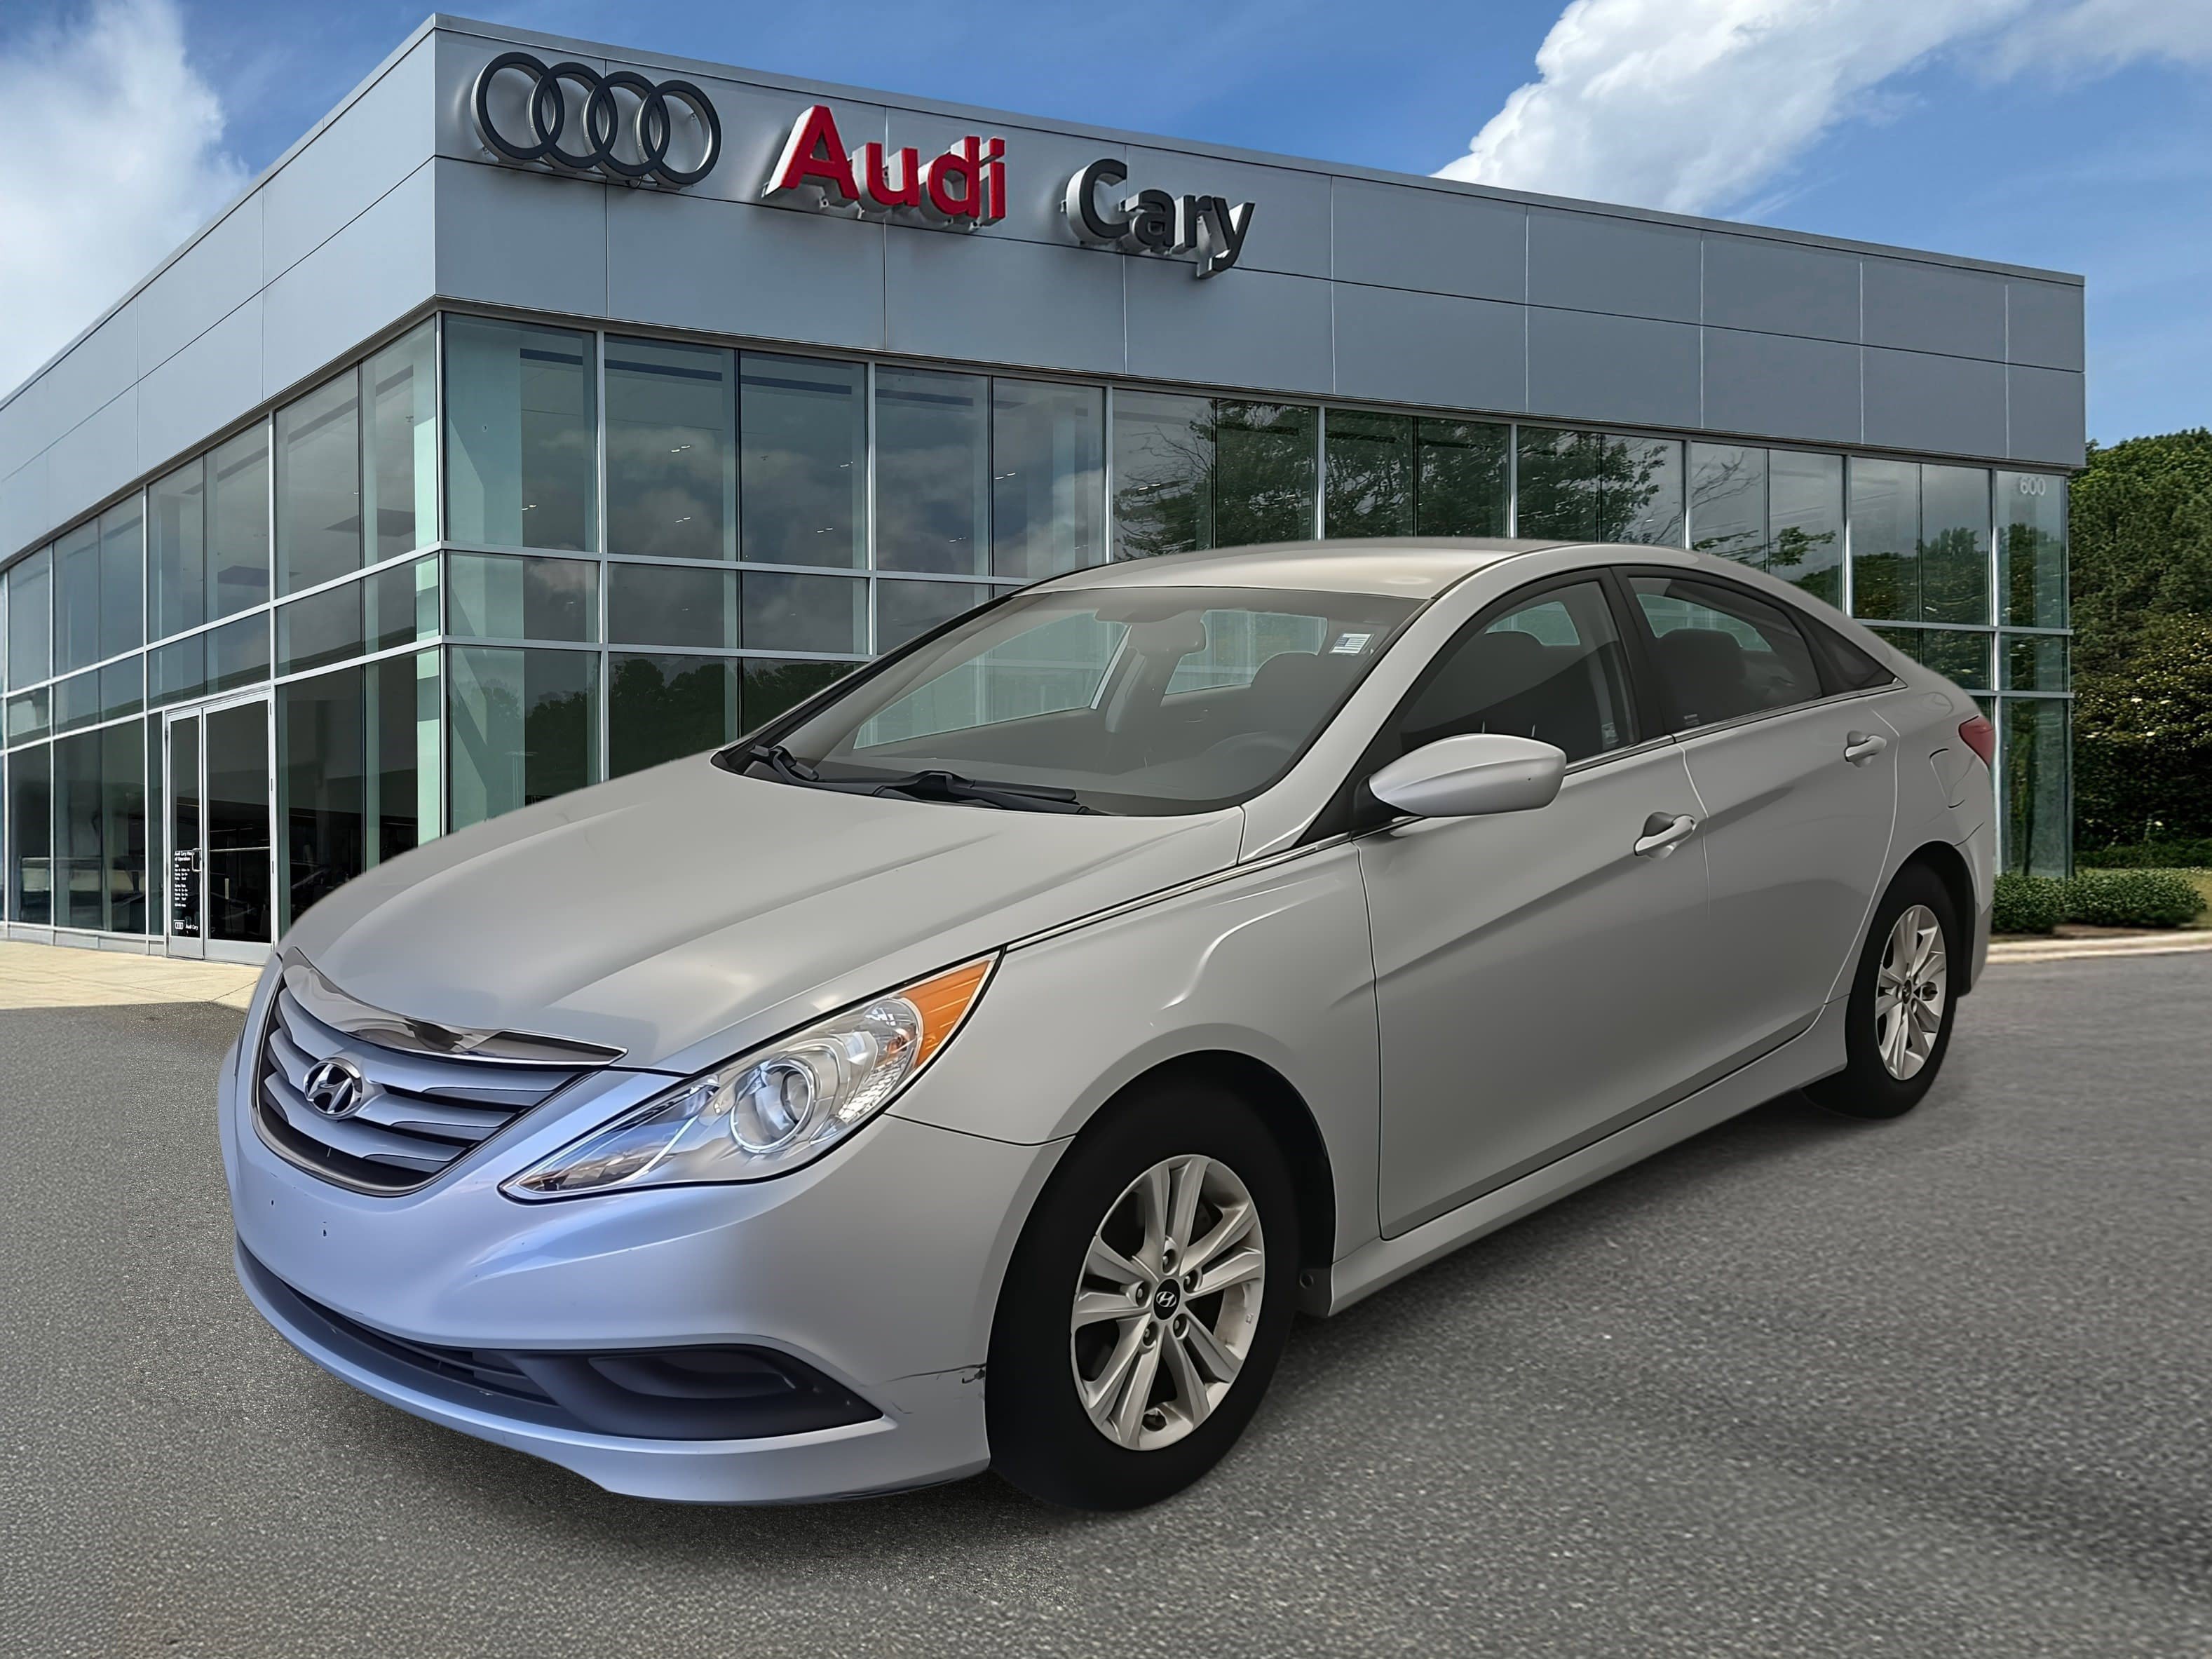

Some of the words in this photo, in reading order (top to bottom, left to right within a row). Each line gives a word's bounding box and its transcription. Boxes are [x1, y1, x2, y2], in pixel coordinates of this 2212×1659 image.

[770, 104, 1007, 224] Audi
[1064, 158, 1256, 275] Cary
[2020, 477, 2046, 496] 600
